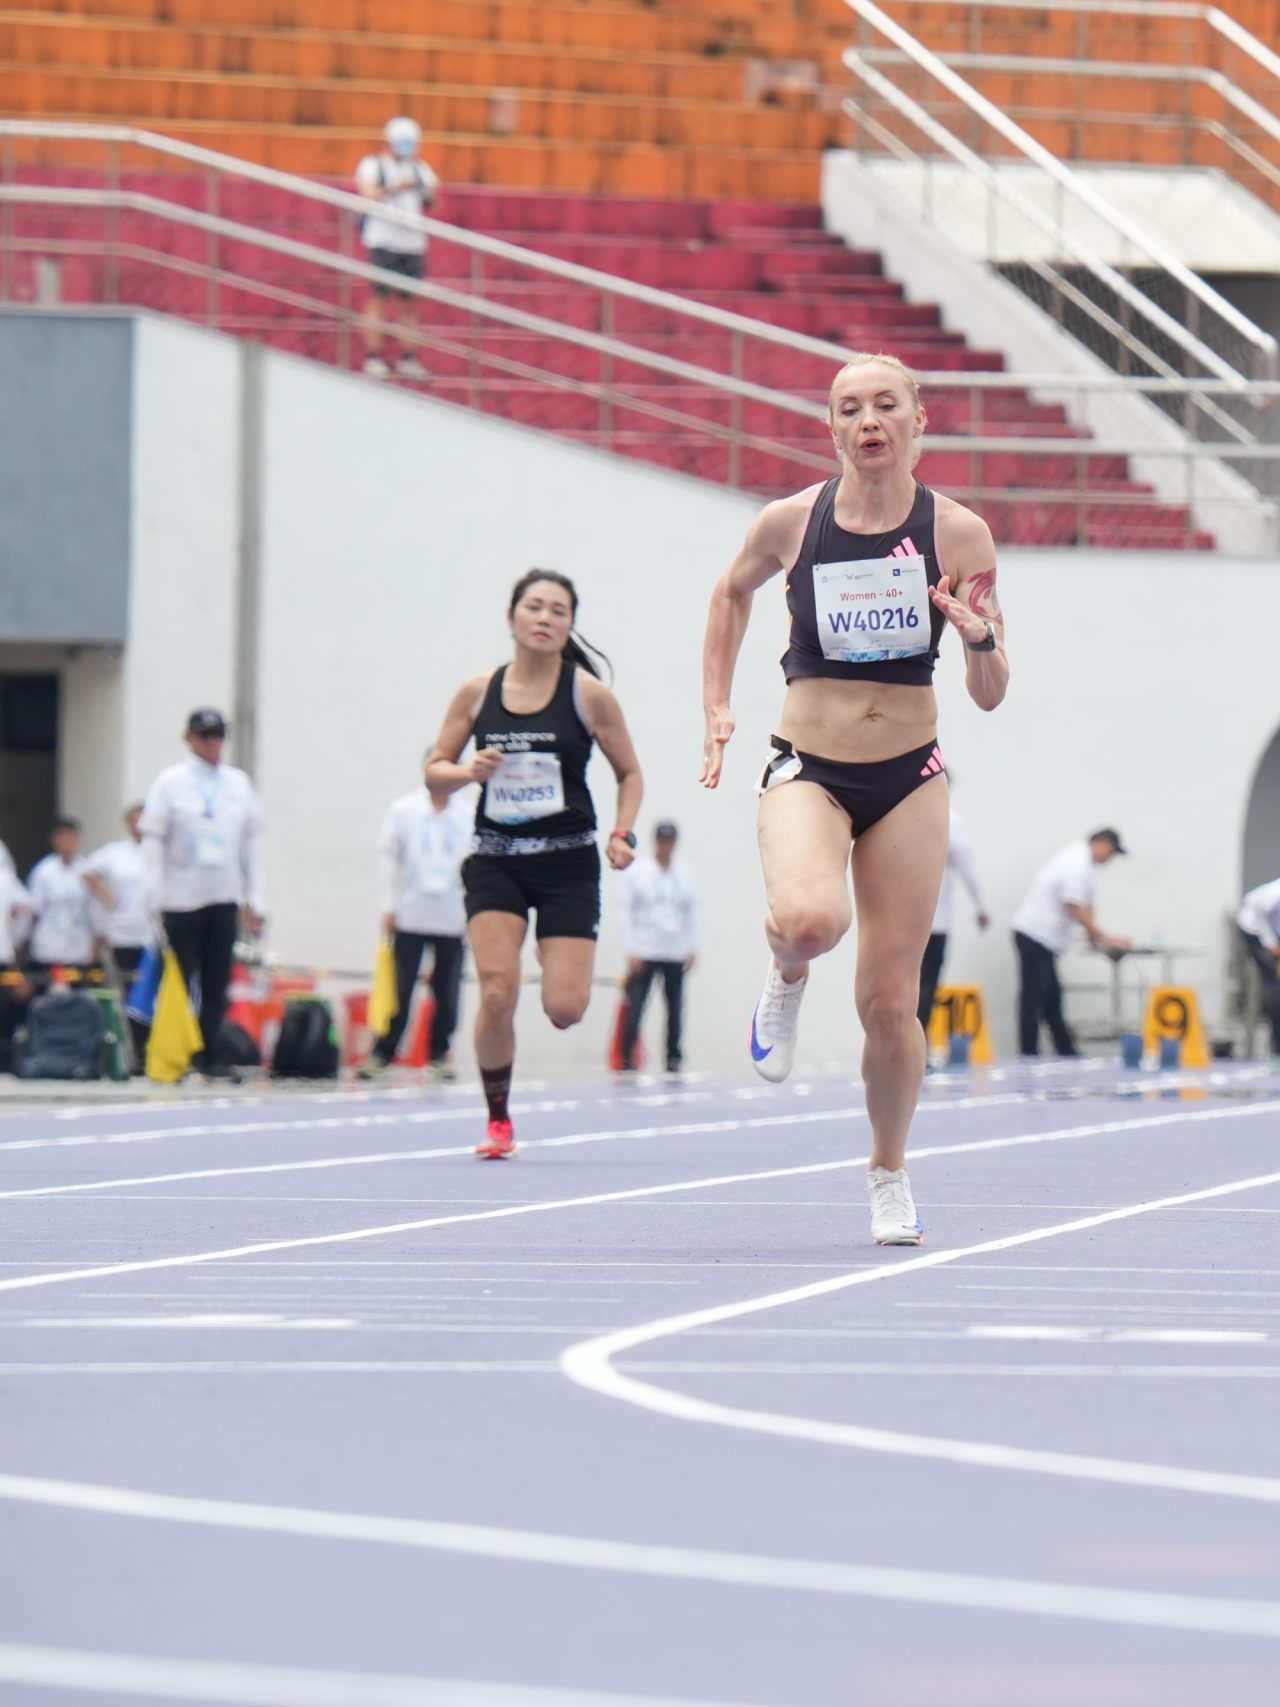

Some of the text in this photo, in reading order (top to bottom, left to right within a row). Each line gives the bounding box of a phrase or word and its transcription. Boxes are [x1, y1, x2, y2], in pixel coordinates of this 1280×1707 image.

[840, 591, 877, 601] Women
[885, 588, 903, 598] 40+
[828, 606, 919, 634] W40216
[485, 732, 557, 742] new balance
[505, 740, 532, 752] club
[937, 994, 983, 1039] 10
[1155, 996, 1188, 1040] 9
